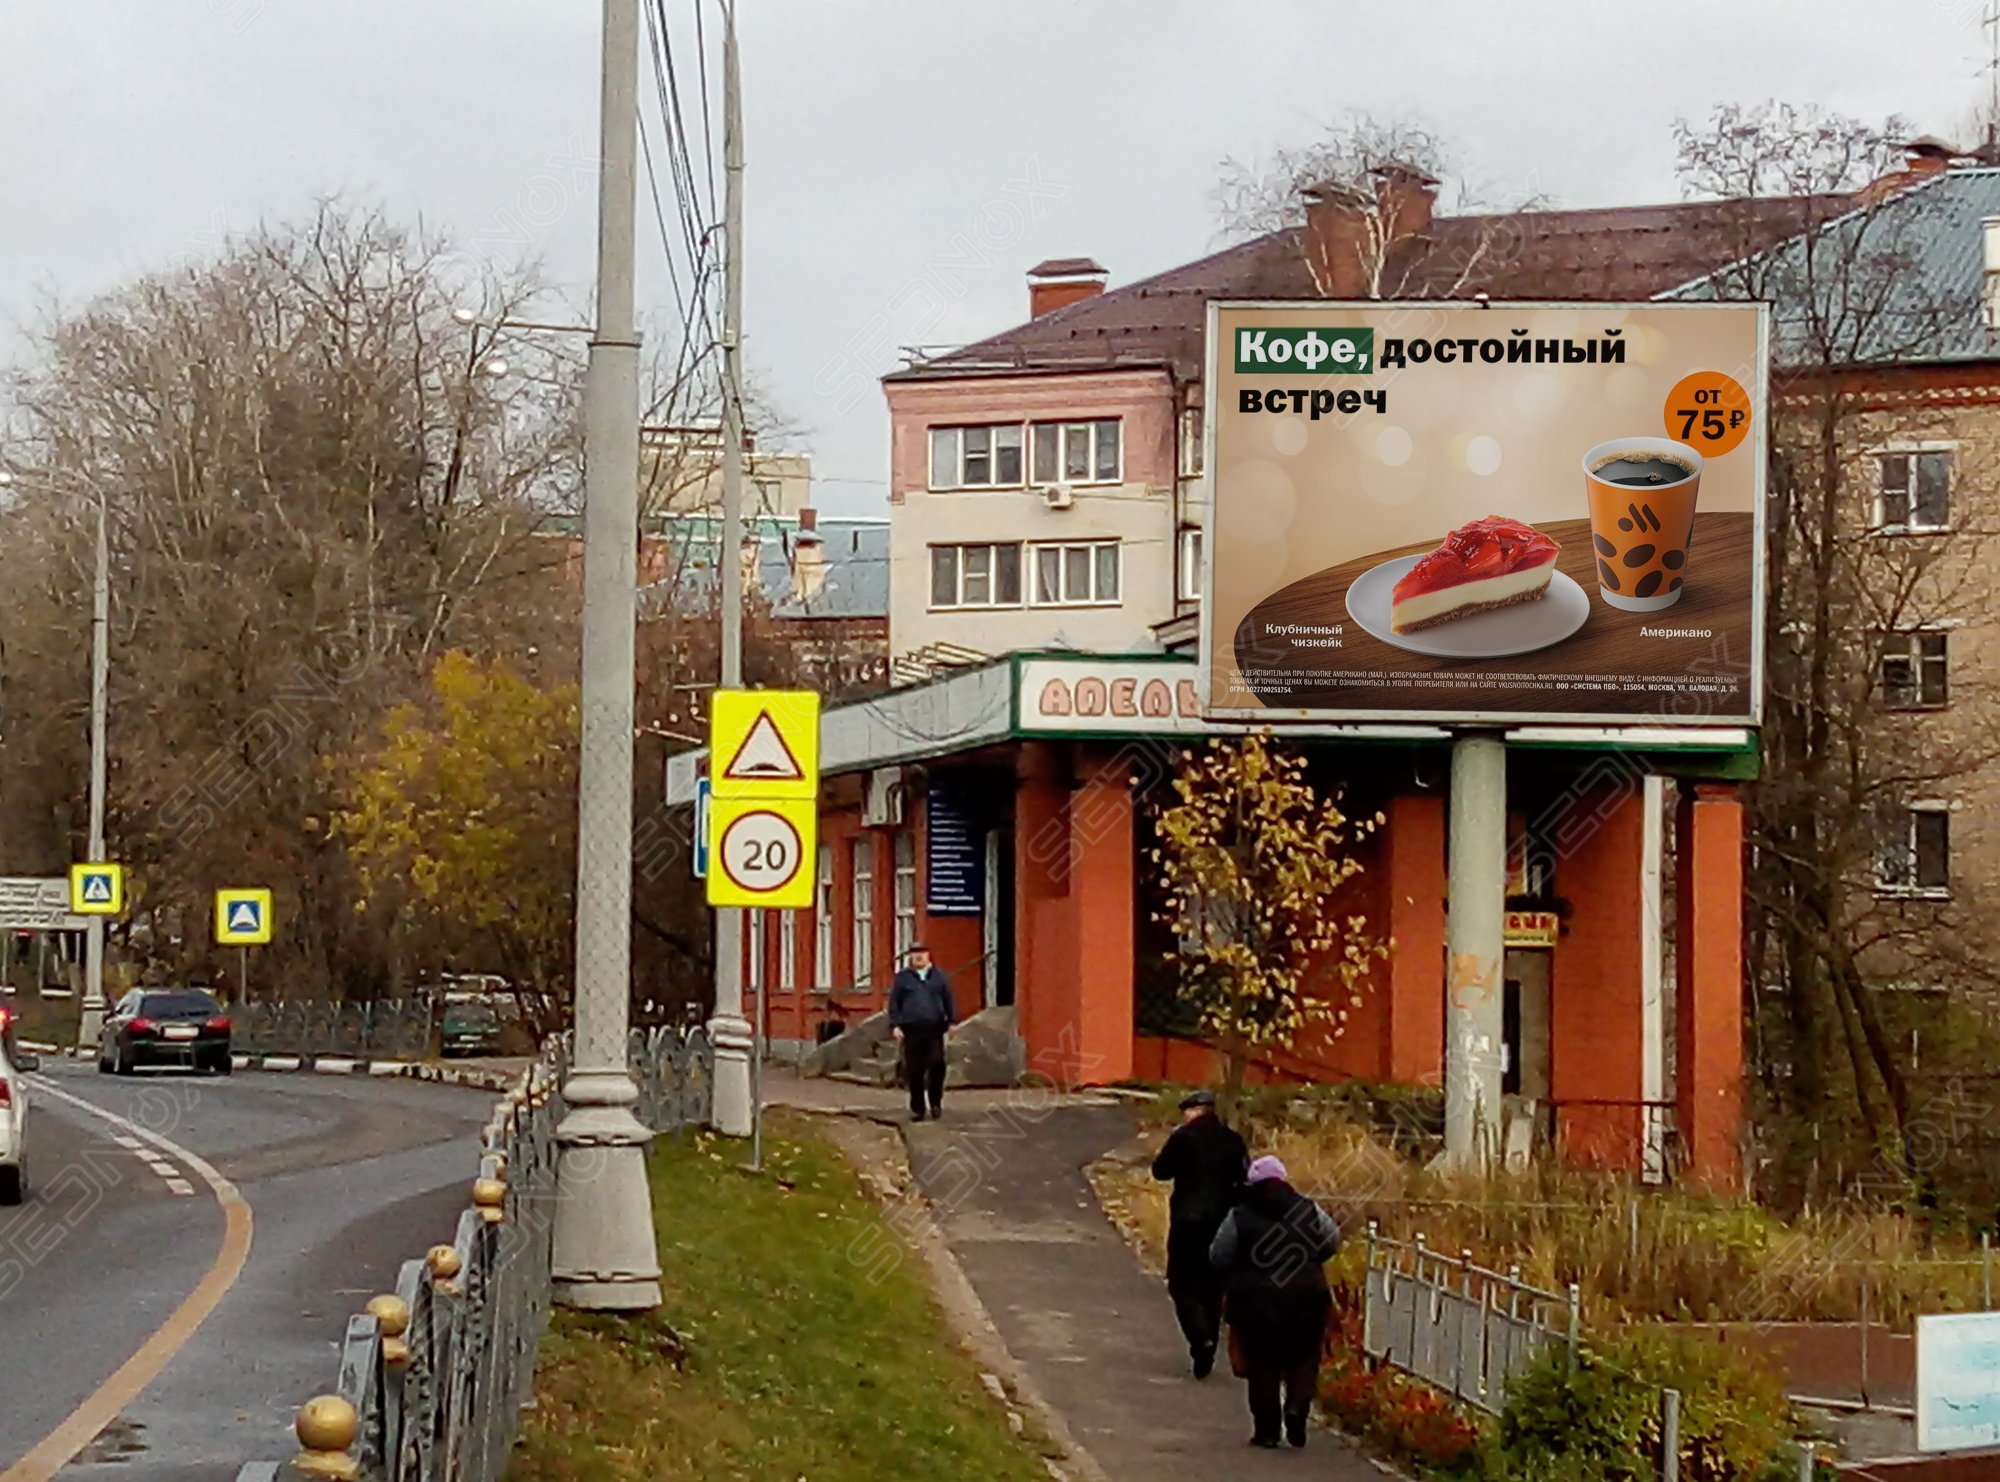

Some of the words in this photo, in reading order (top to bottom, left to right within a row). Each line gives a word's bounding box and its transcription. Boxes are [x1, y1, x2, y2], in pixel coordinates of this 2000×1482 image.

[1240, 331, 1368, 370] Кофе,
[1380, 329, 1626, 369] достойный
[1239, 389, 1387, 420] встреч
[1265, 623, 1343, 636] Клубничный
[1639, 626, 1712, 639] Американо
[1291, 637, 1343, 648] чизкейк
[1246, 668, 1291, 677] ДЕЙСТВИТЕЛЬНА
[1306, 670, 1331, 678] ПОКУПКЕ
[1333, 671, 1366, 679] АМЕРИКАНО
[1390, 672, 1432, 680] ИЗОБРАЖЕНИЕ
[1433, 672, 1453, 680] ТОВАРА
[1485, 673, 1536, 681] СООТВЕТСТВОВАТЬ
[1538, 674, 1583, 682] ФАКТИЧЕСКОМУ
[1619, 675, 1635, 683] ВИДУ.
[1643, 675, 1688, 684] ИНФОРМАЦИЕЙ
[1696, 676, 1738, 684] РЕАЛИЗУЕМЫХ
[1261, 678, 1283, 686] ТОЧНЫХ
[1284, 678, 1303, 686] ЦЕНАХ
[1339, 679, 1384, 687] ОЗНАКОМИТЬСЯ
[1480, 680, 1497, 689] САЙТЕ
[1556, 682, 1569, 690] ООО
[1648, 684, 1676, 693] МОСКВА,
[743, 840, 786, 870] 20
